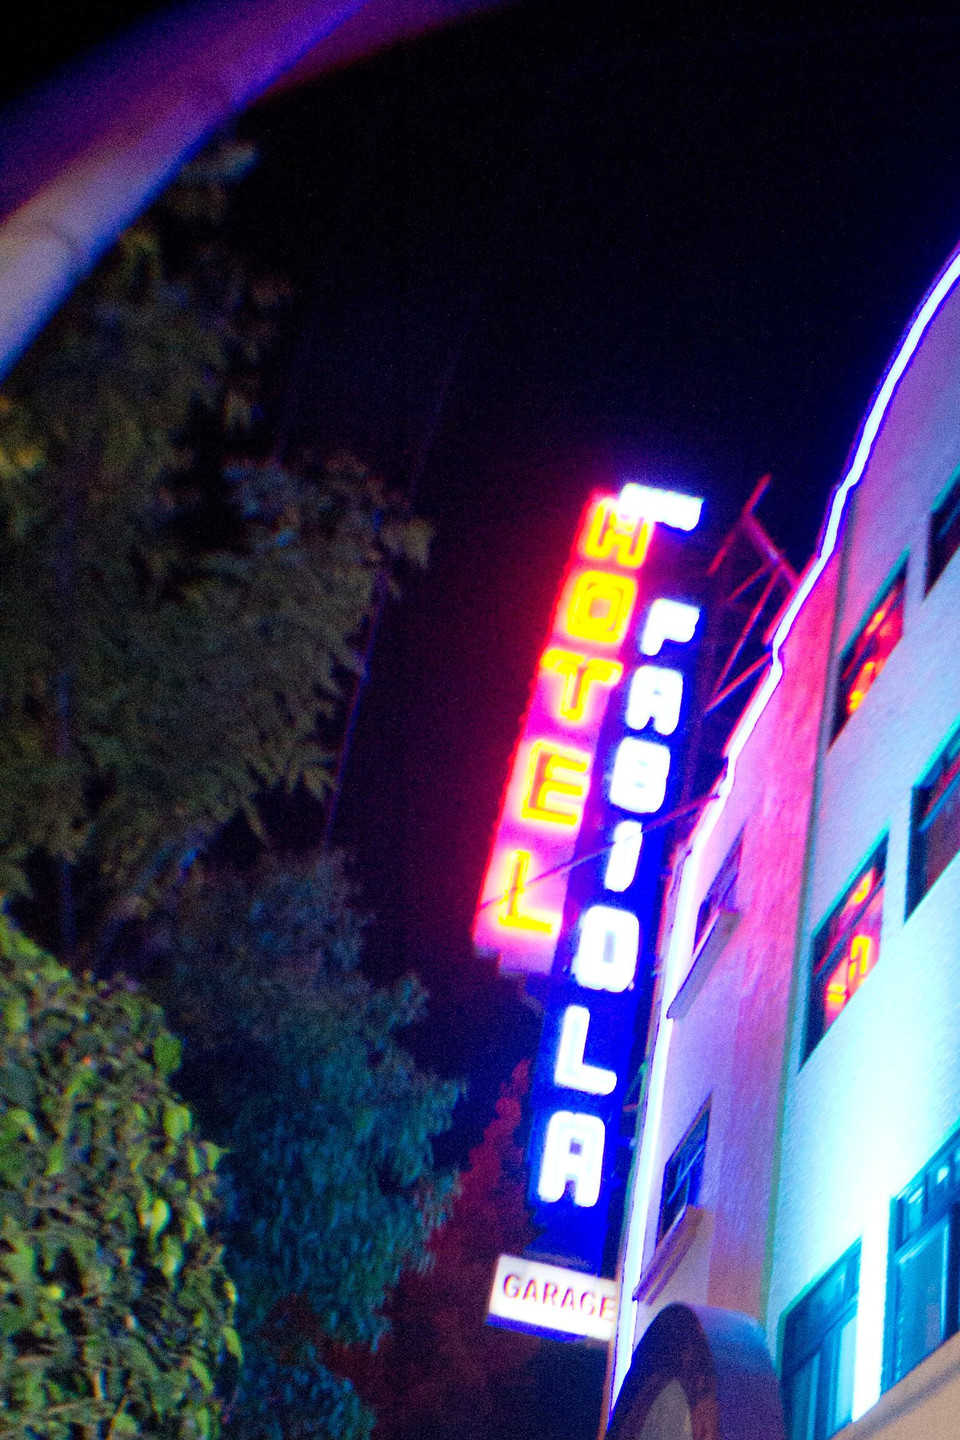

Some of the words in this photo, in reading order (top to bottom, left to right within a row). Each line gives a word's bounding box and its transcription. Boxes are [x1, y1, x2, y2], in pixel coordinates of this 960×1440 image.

[496, 497, 650, 936] HOTEL
[538, 598, 700, 1208] FABIOLA
[503, 1273, 616, 1322] GARAGE
